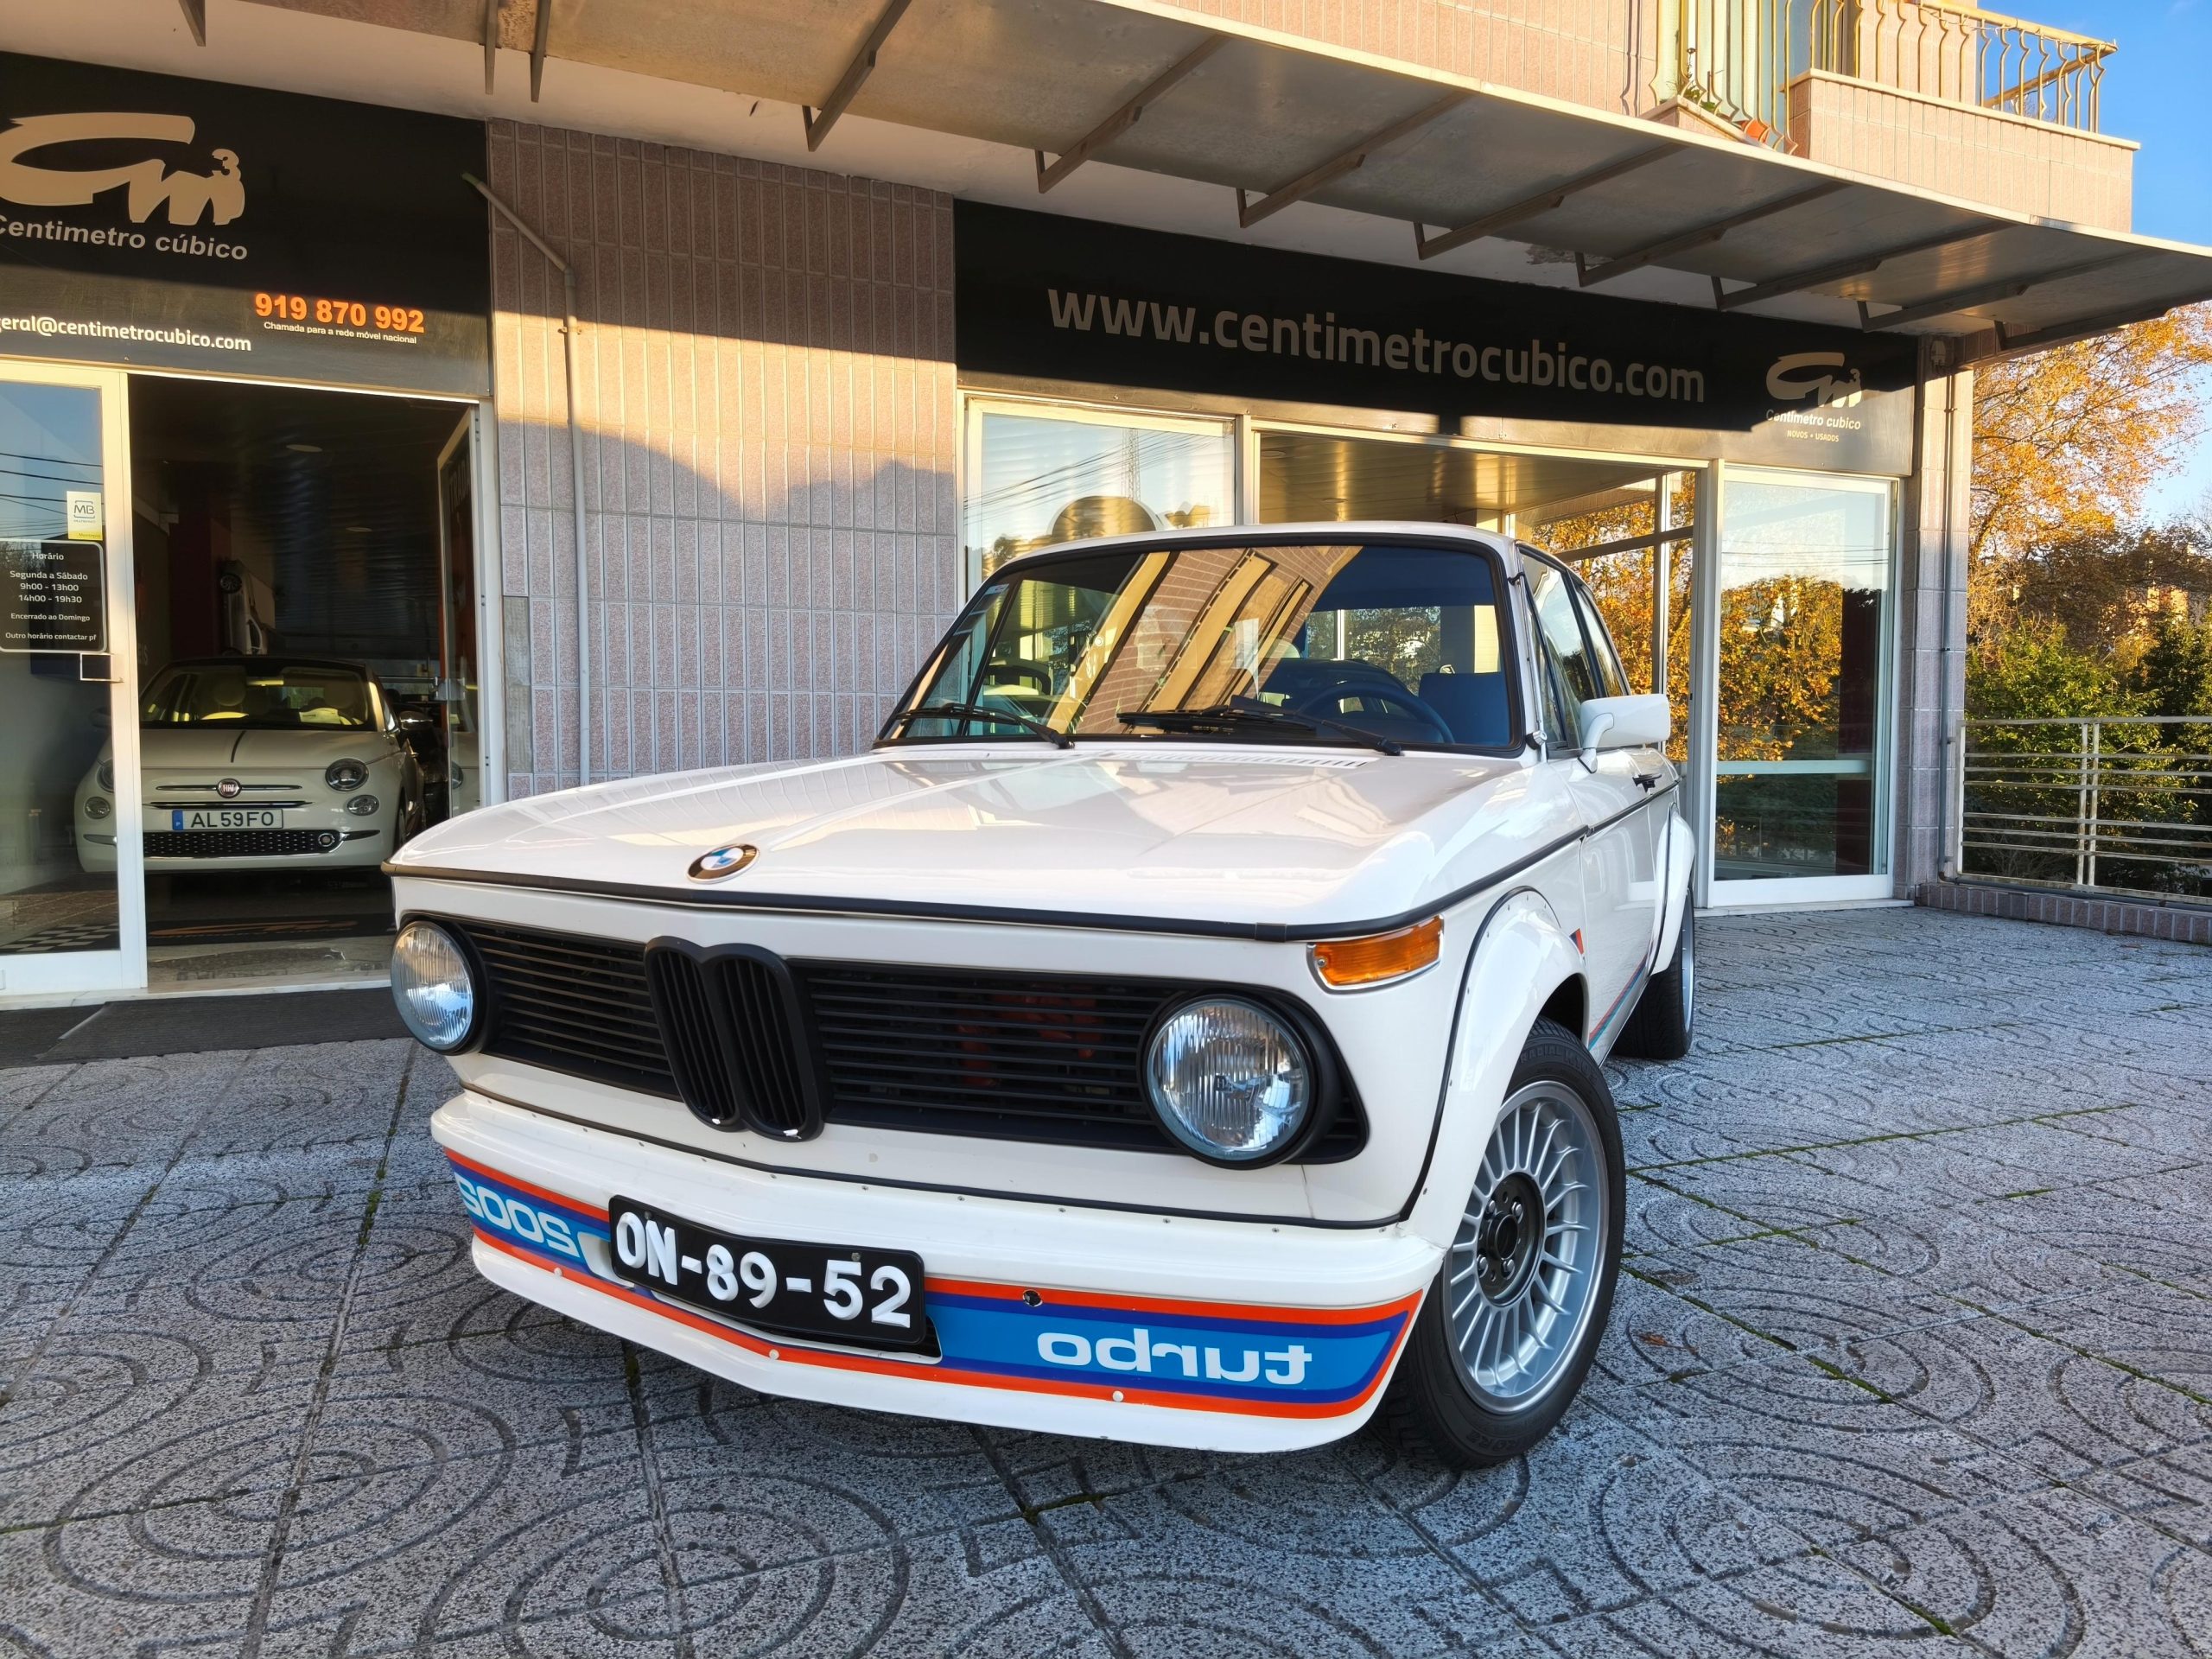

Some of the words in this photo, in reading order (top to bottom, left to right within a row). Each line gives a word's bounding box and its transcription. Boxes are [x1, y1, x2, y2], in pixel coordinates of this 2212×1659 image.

[155, 233, 248, 260] cúbico
[255, 293, 308, 321] 919
[316, 300, 366, 327] 870
[375, 306, 425, 334] 992
[0, 315, 251, 351] eral@centimetrocubico.com
[264, 321, 305, 333] Chamada
[307, 327, 327, 336] para
[335, 329, 355, 338] rede
[356, 331, 381, 340] móvel
[383, 333, 417, 344] nacional
[1047, 289, 1706, 403] www.centimetrocubico.com
[1766, 409, 1824, 427] Centimetro
[1787, 429, 1808, 439] NOVOS
[1815, 433, 1840, 442] USADOS
[73, 504, 95, 515] MB
[32, 552, 65, 561] Horário
[10, 570, 48, 580] Segunda
[56, 572, 88, 581] Sábado
[52, 583, 79, 592] 13h00
[58, 613, 91, 622] Domingo
[615, 1211, 912, 1330] ON-89-52
